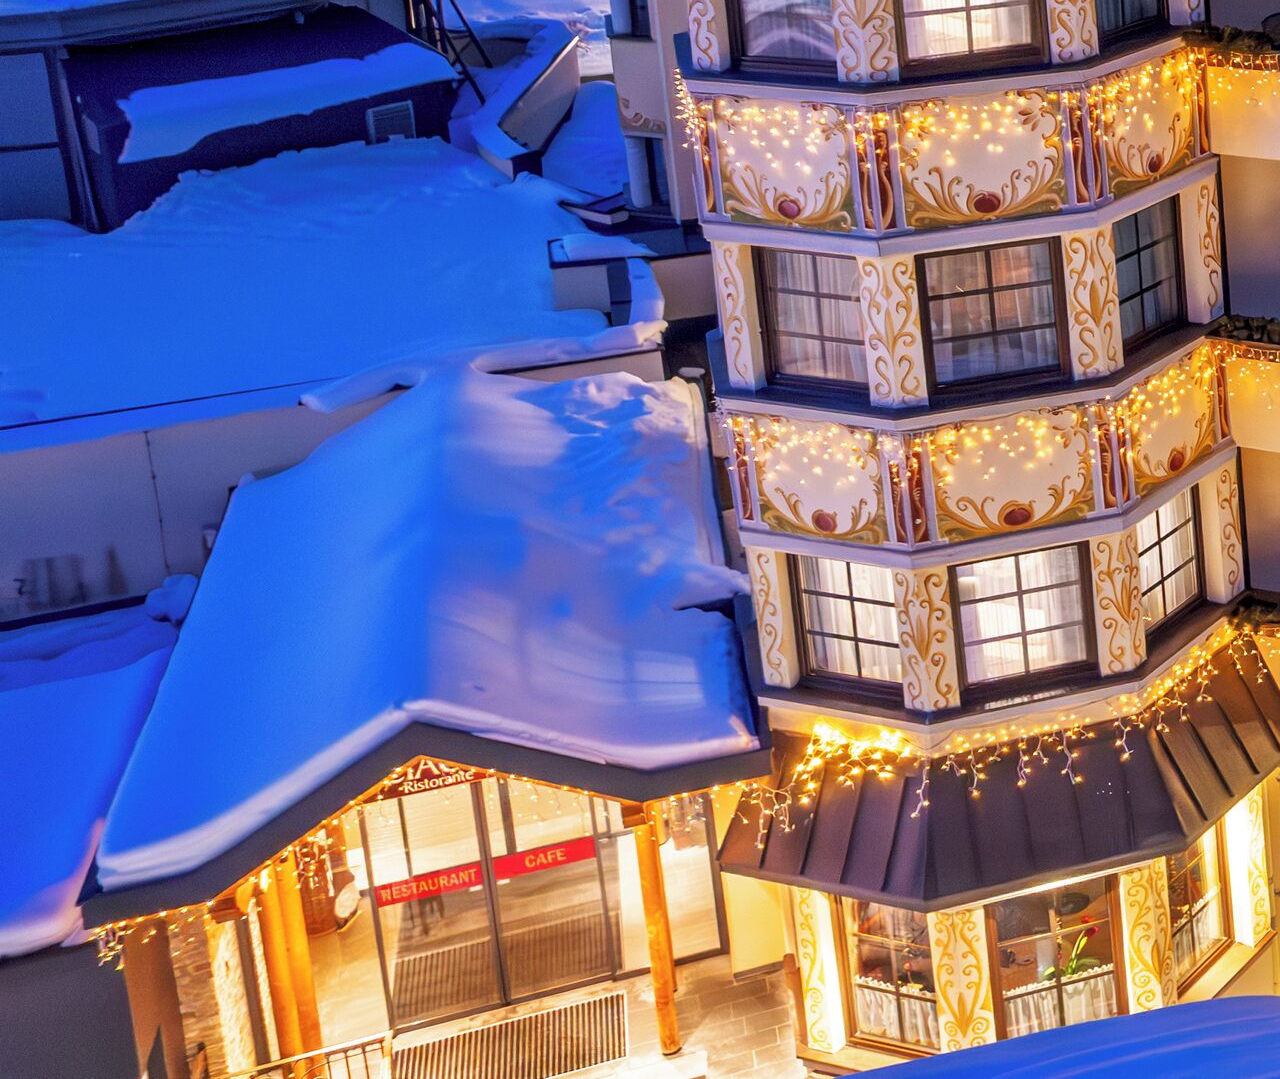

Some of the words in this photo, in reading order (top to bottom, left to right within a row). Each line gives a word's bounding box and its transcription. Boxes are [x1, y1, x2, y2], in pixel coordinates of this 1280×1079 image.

[402, 770, 475, 793] Ristorante
[380, 868, 477, 902] RESTAURANT
[524, 848, 567, 868] CAFE
